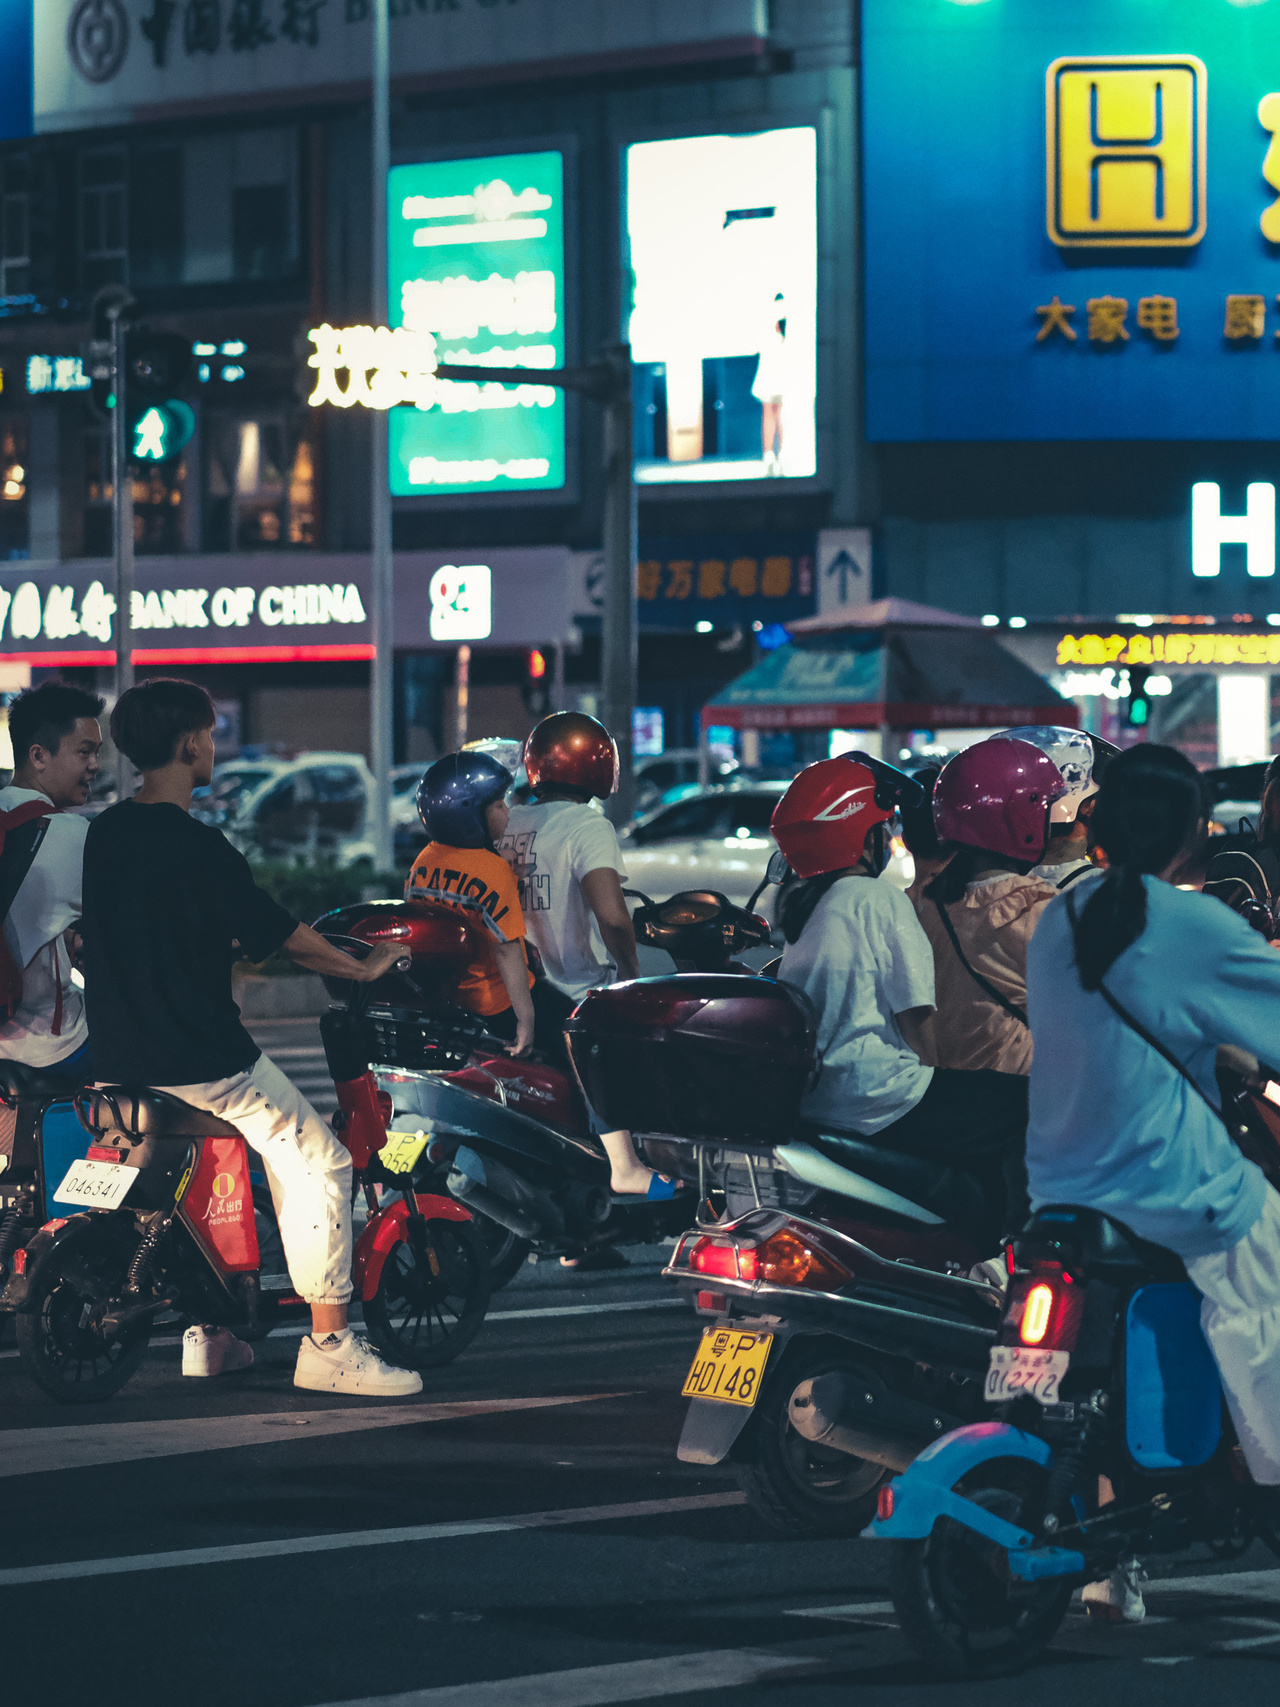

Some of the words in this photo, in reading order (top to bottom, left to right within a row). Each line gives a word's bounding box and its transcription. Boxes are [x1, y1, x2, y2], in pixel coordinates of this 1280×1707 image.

[1034, 297, 1180, 343] 大家电
[129, 588, 209, 630] BANK
[210, 586, 256, 627] OF
[258, 582, 367, 626] CHINA
[66, 1179, 121, 1199] 046341
[201, 1197, 243, 1220] 人民出行
[686, 1360, 756, 1399] HD148
